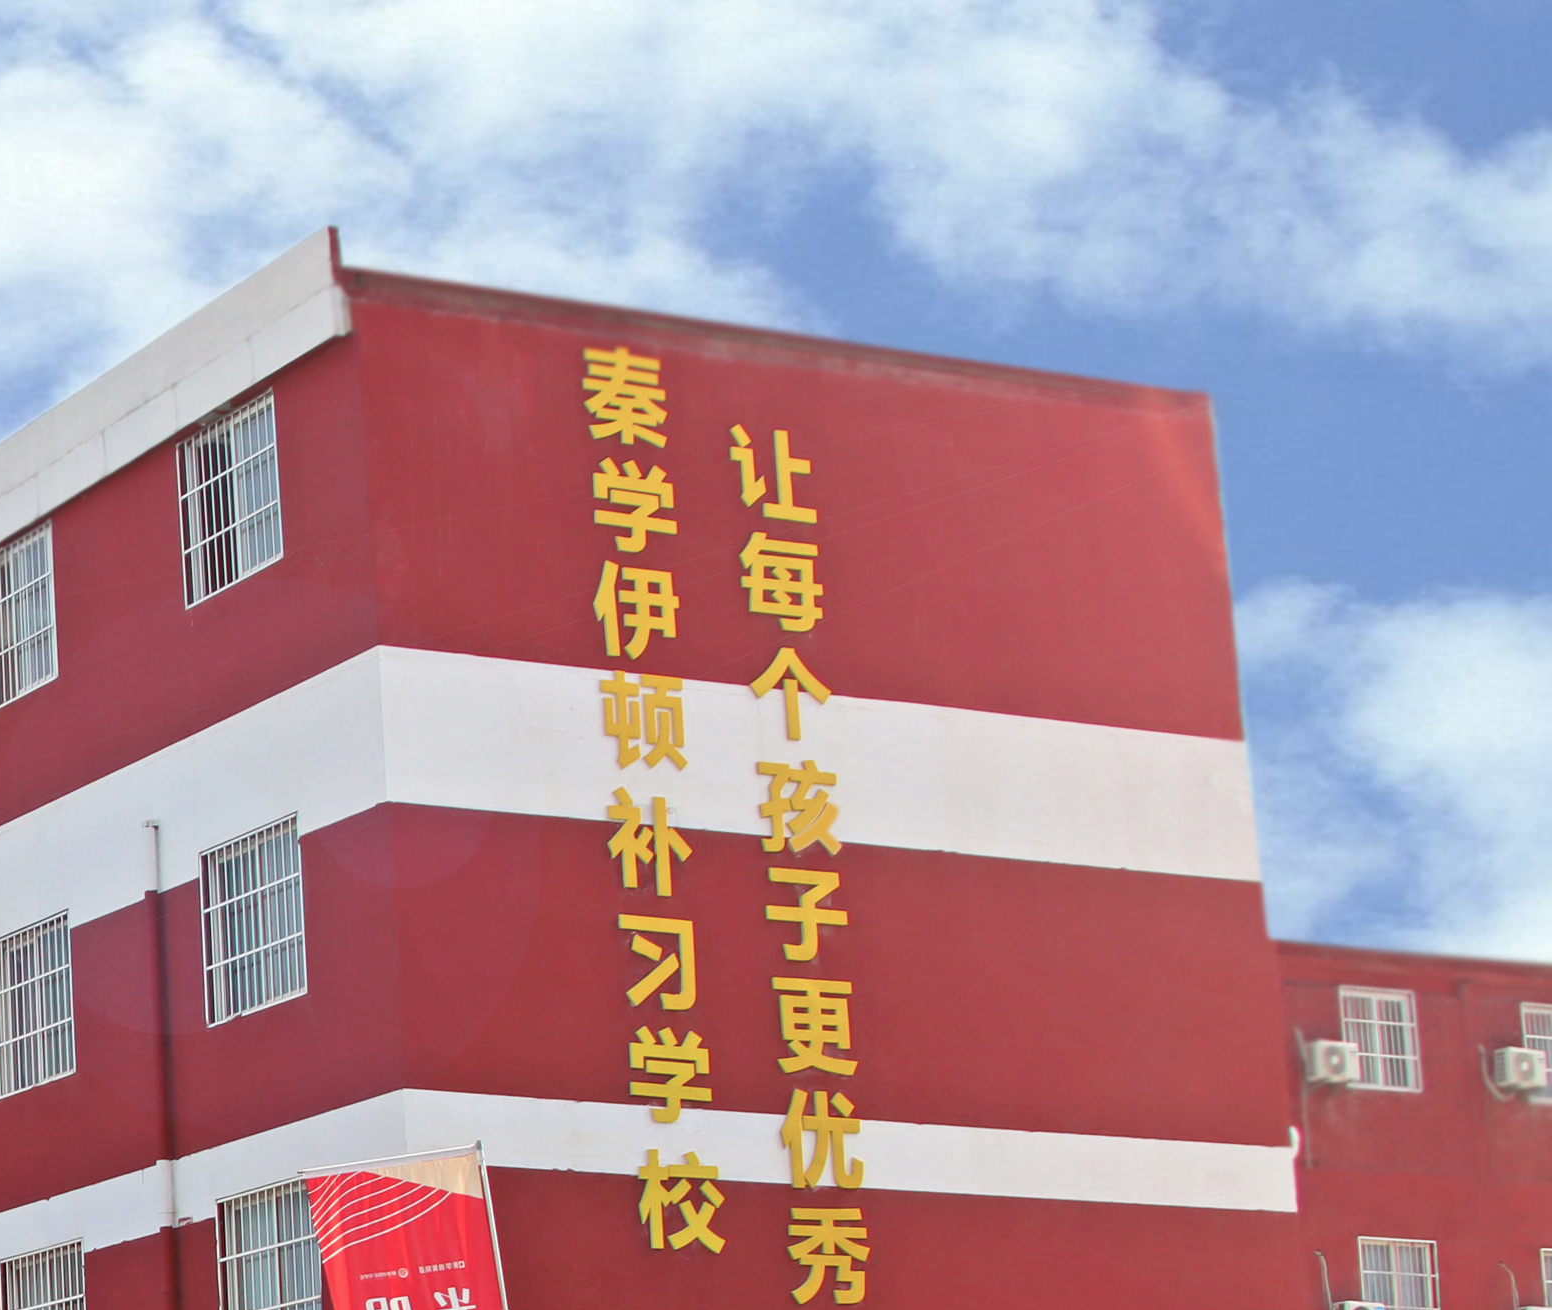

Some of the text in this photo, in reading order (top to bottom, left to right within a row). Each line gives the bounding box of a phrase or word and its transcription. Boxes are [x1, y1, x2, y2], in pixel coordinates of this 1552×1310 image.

[582, 347, 726, 1254] 秦学伊顿补习学校
[729, 424, 871, 1305] 让每个孩子更优秀
